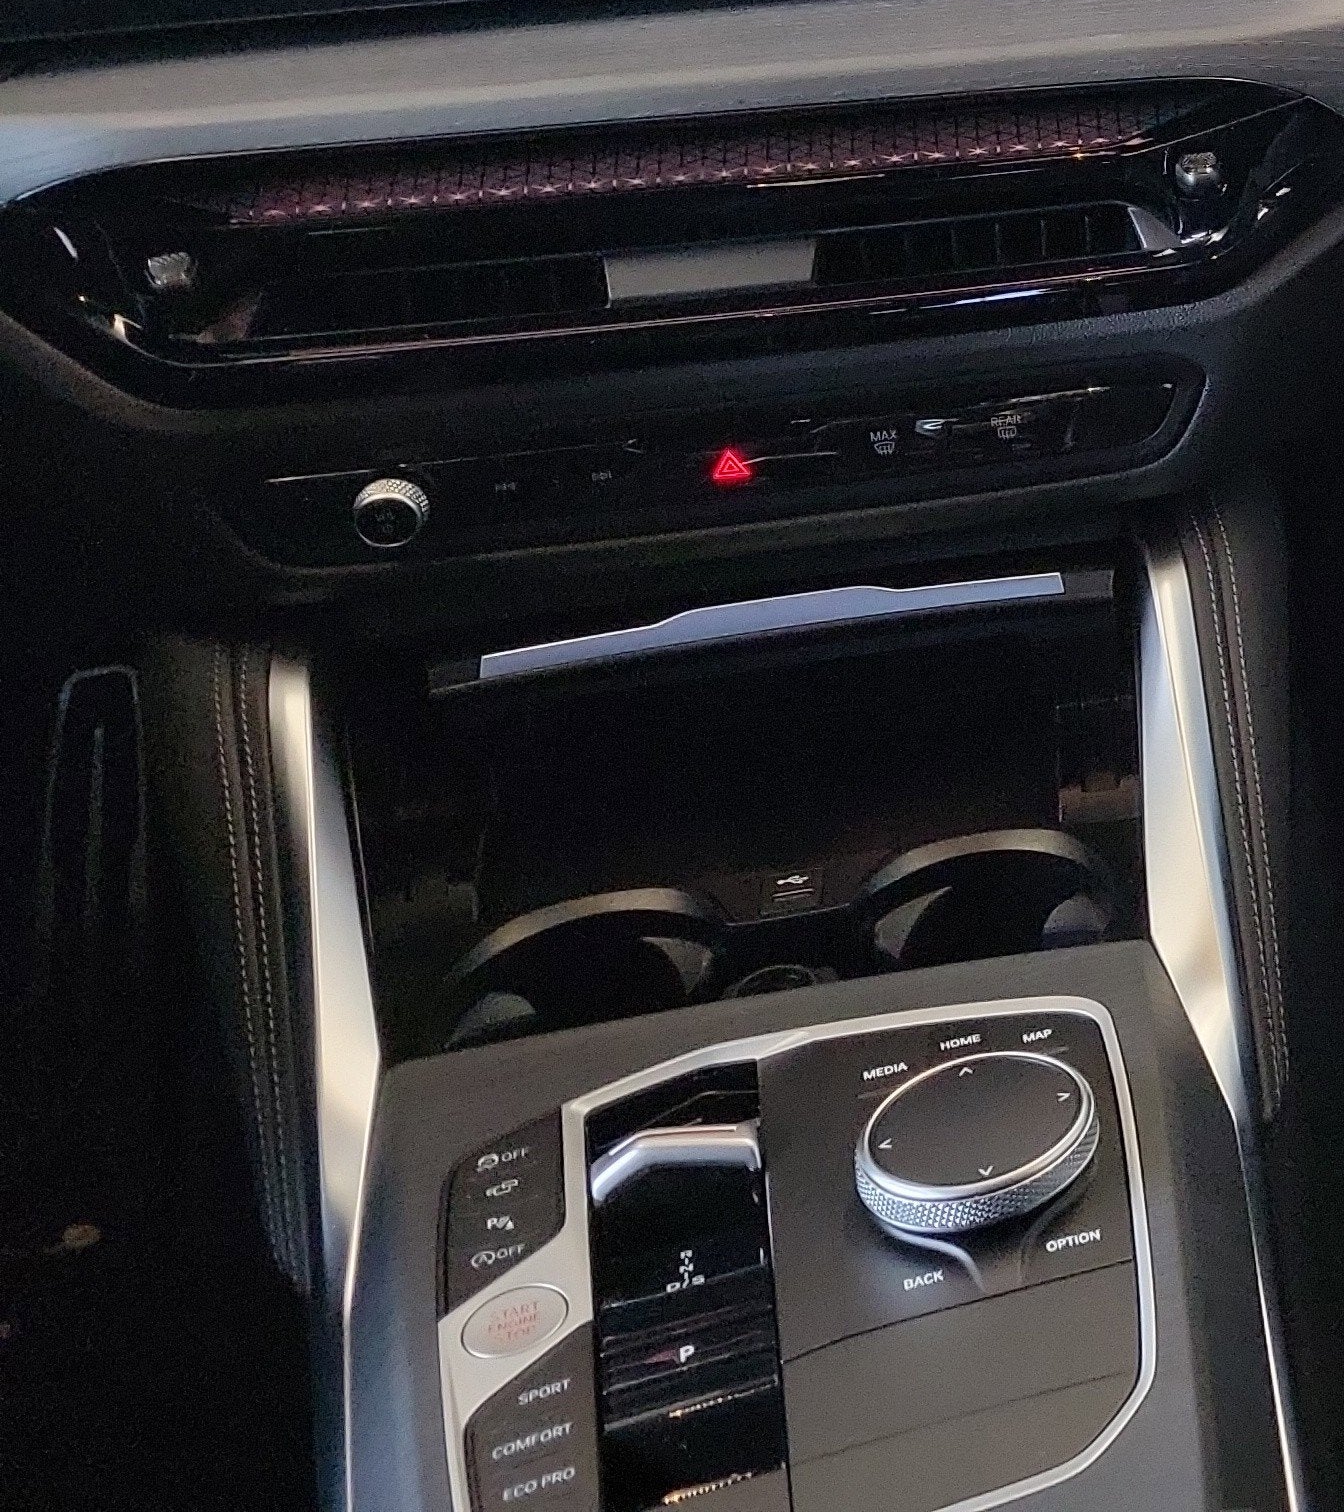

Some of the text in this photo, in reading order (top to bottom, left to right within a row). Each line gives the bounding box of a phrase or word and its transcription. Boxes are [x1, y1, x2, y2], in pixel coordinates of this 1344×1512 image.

[870, 429, 898, 443] MAX
[939, 1033, 982, 1051] HOME
[1022, 1028, 1053, 1044] MAP
[862, 1061, 909, 1082] MEDIA
[501, 1147, 531, 1162] OFF
[1045, 1228, 1102, 1253] OPTION
[496, 1243, 526, 1259] OFF
[903, 1269, 945, 1292] BACK
[680, 1345, 695, 1364] P
[518, 1377, 571, 1406] SPORT
[491, 1422, 574, 1461] COMFORT
[502, 1466, 576, 1502] ECO PRO
